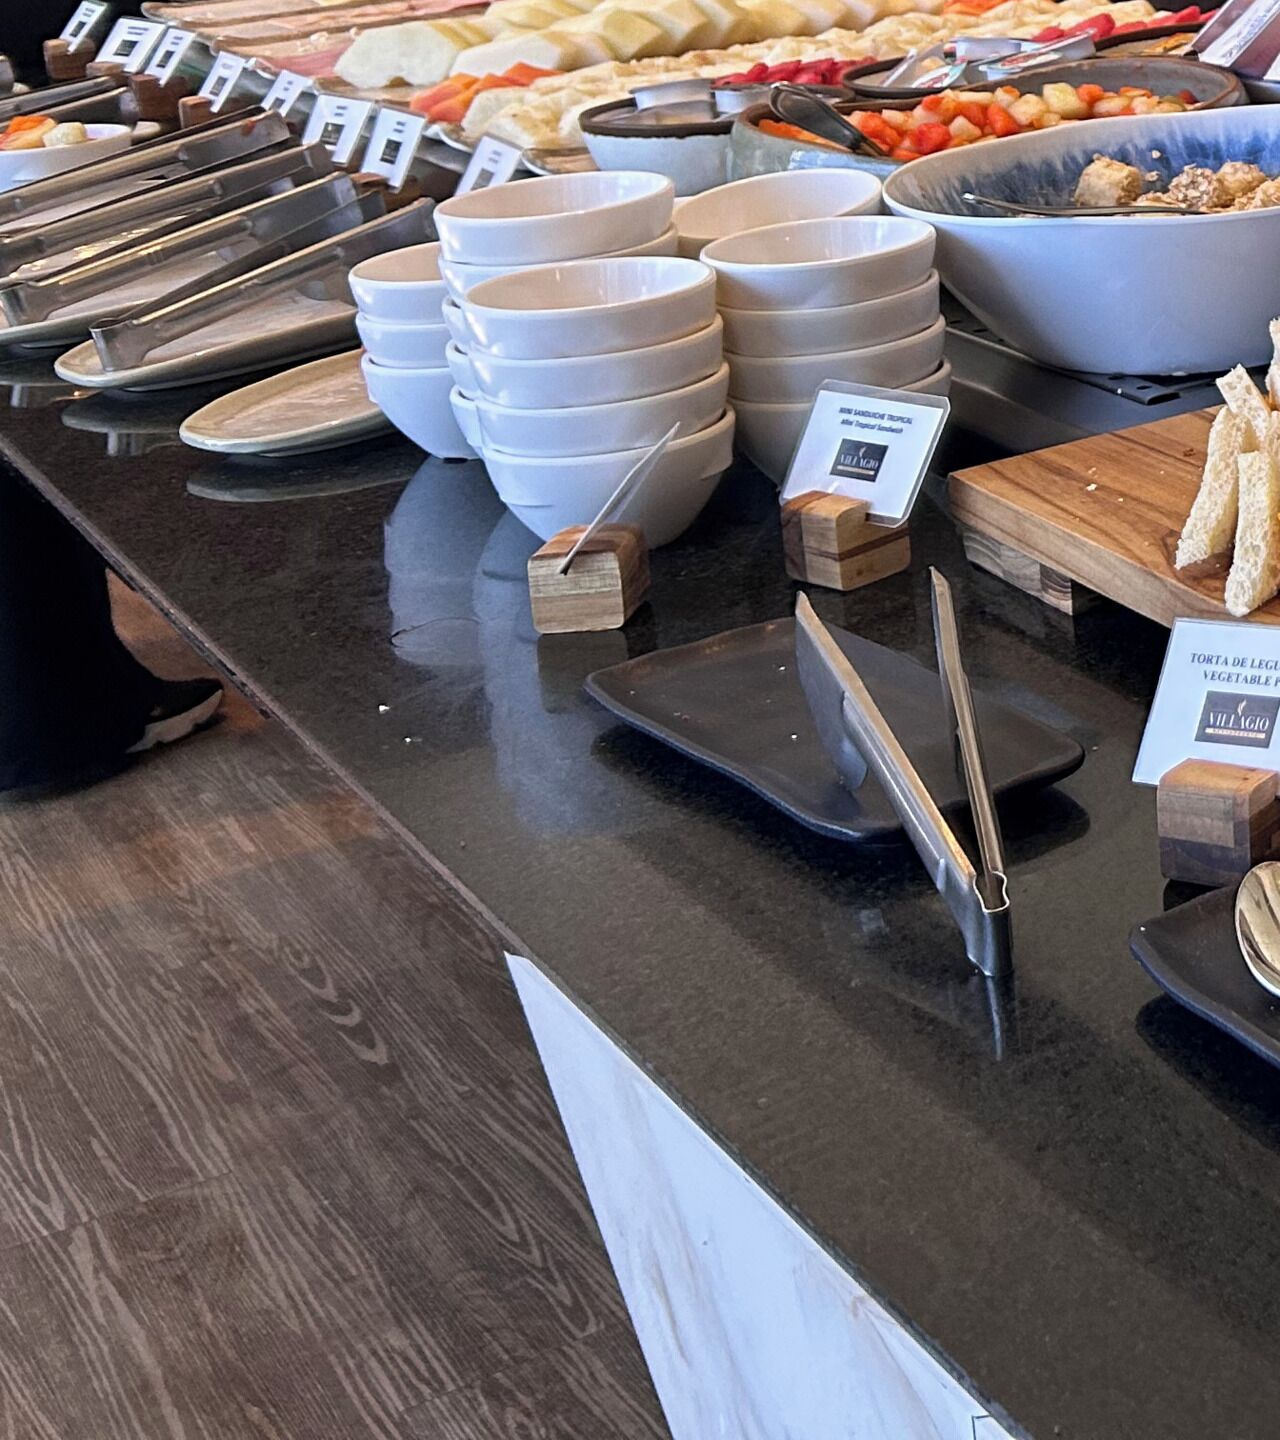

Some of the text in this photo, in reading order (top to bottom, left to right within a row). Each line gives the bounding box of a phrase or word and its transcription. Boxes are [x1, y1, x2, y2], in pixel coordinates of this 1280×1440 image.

[1190, 652, 1228, 667] TORTA
[1232, 656, 1249, 668] DE
[1202, 669, 1271, 687] VEGETABLE
[1208, 710, 1270, 732] VILLAGIO
